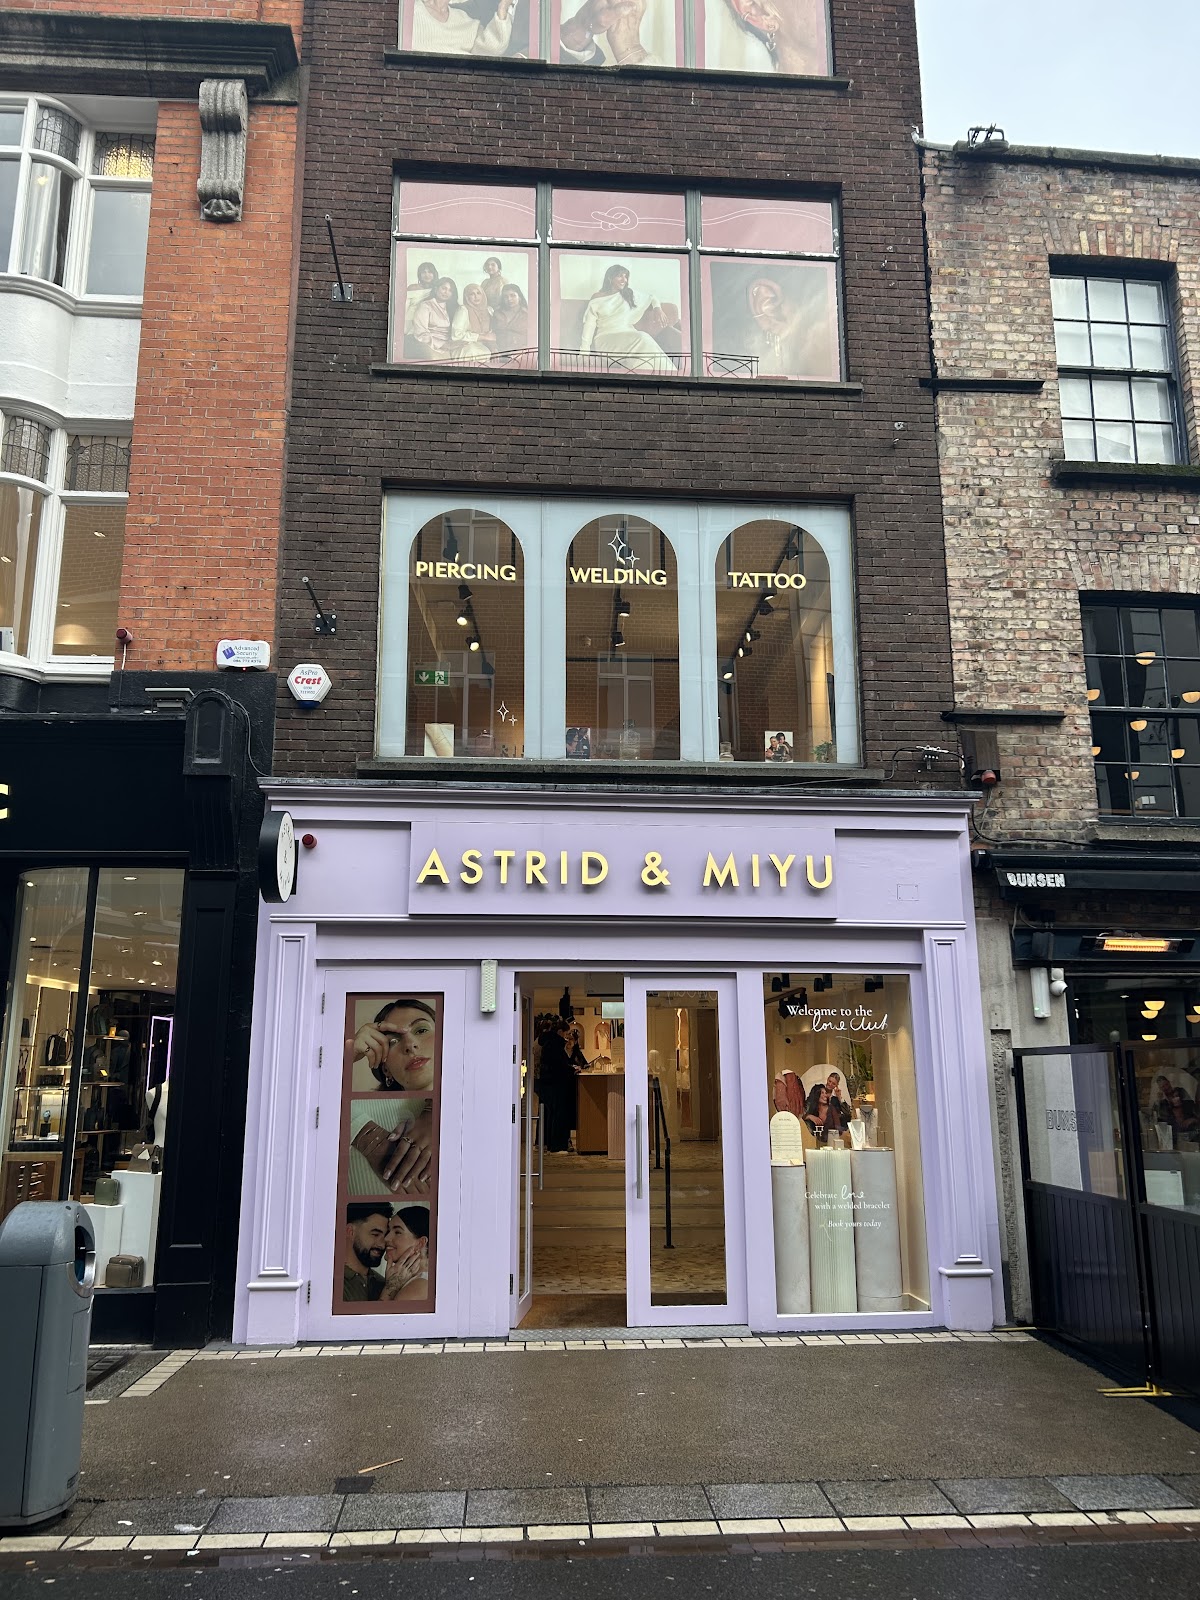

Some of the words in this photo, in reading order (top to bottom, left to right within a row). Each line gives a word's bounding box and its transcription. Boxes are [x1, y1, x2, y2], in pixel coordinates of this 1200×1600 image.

[416, 561, 517, 582] PIERCING
[569, 566, 668, 586] WELDING
[727, 572, 807, 589] TATTOO
[294, 676, 322, 685] Crest
[416, 847, 609, 885] ASTRID
[640, 851, 672, 887] &
[702, 851, 833, 889] MIYU
[786, 1004, 837, 1016] Welcome
[840, 1008, 852, 1016] to
[855, 1004, 873, 1016] the
[812, 1011, 847, 1032] love
[804, 1191, 838, 1199] Celebrate
[814, 1201, 831, 1210] with
[838, 1201, 862, 1210] welded
[863, 1201, 891, 1210] bracelet
[828, 1220, 844, 1228] Book
[844, 1222, 862, 1230] yours
[863, 1219, 882, 1230] today
